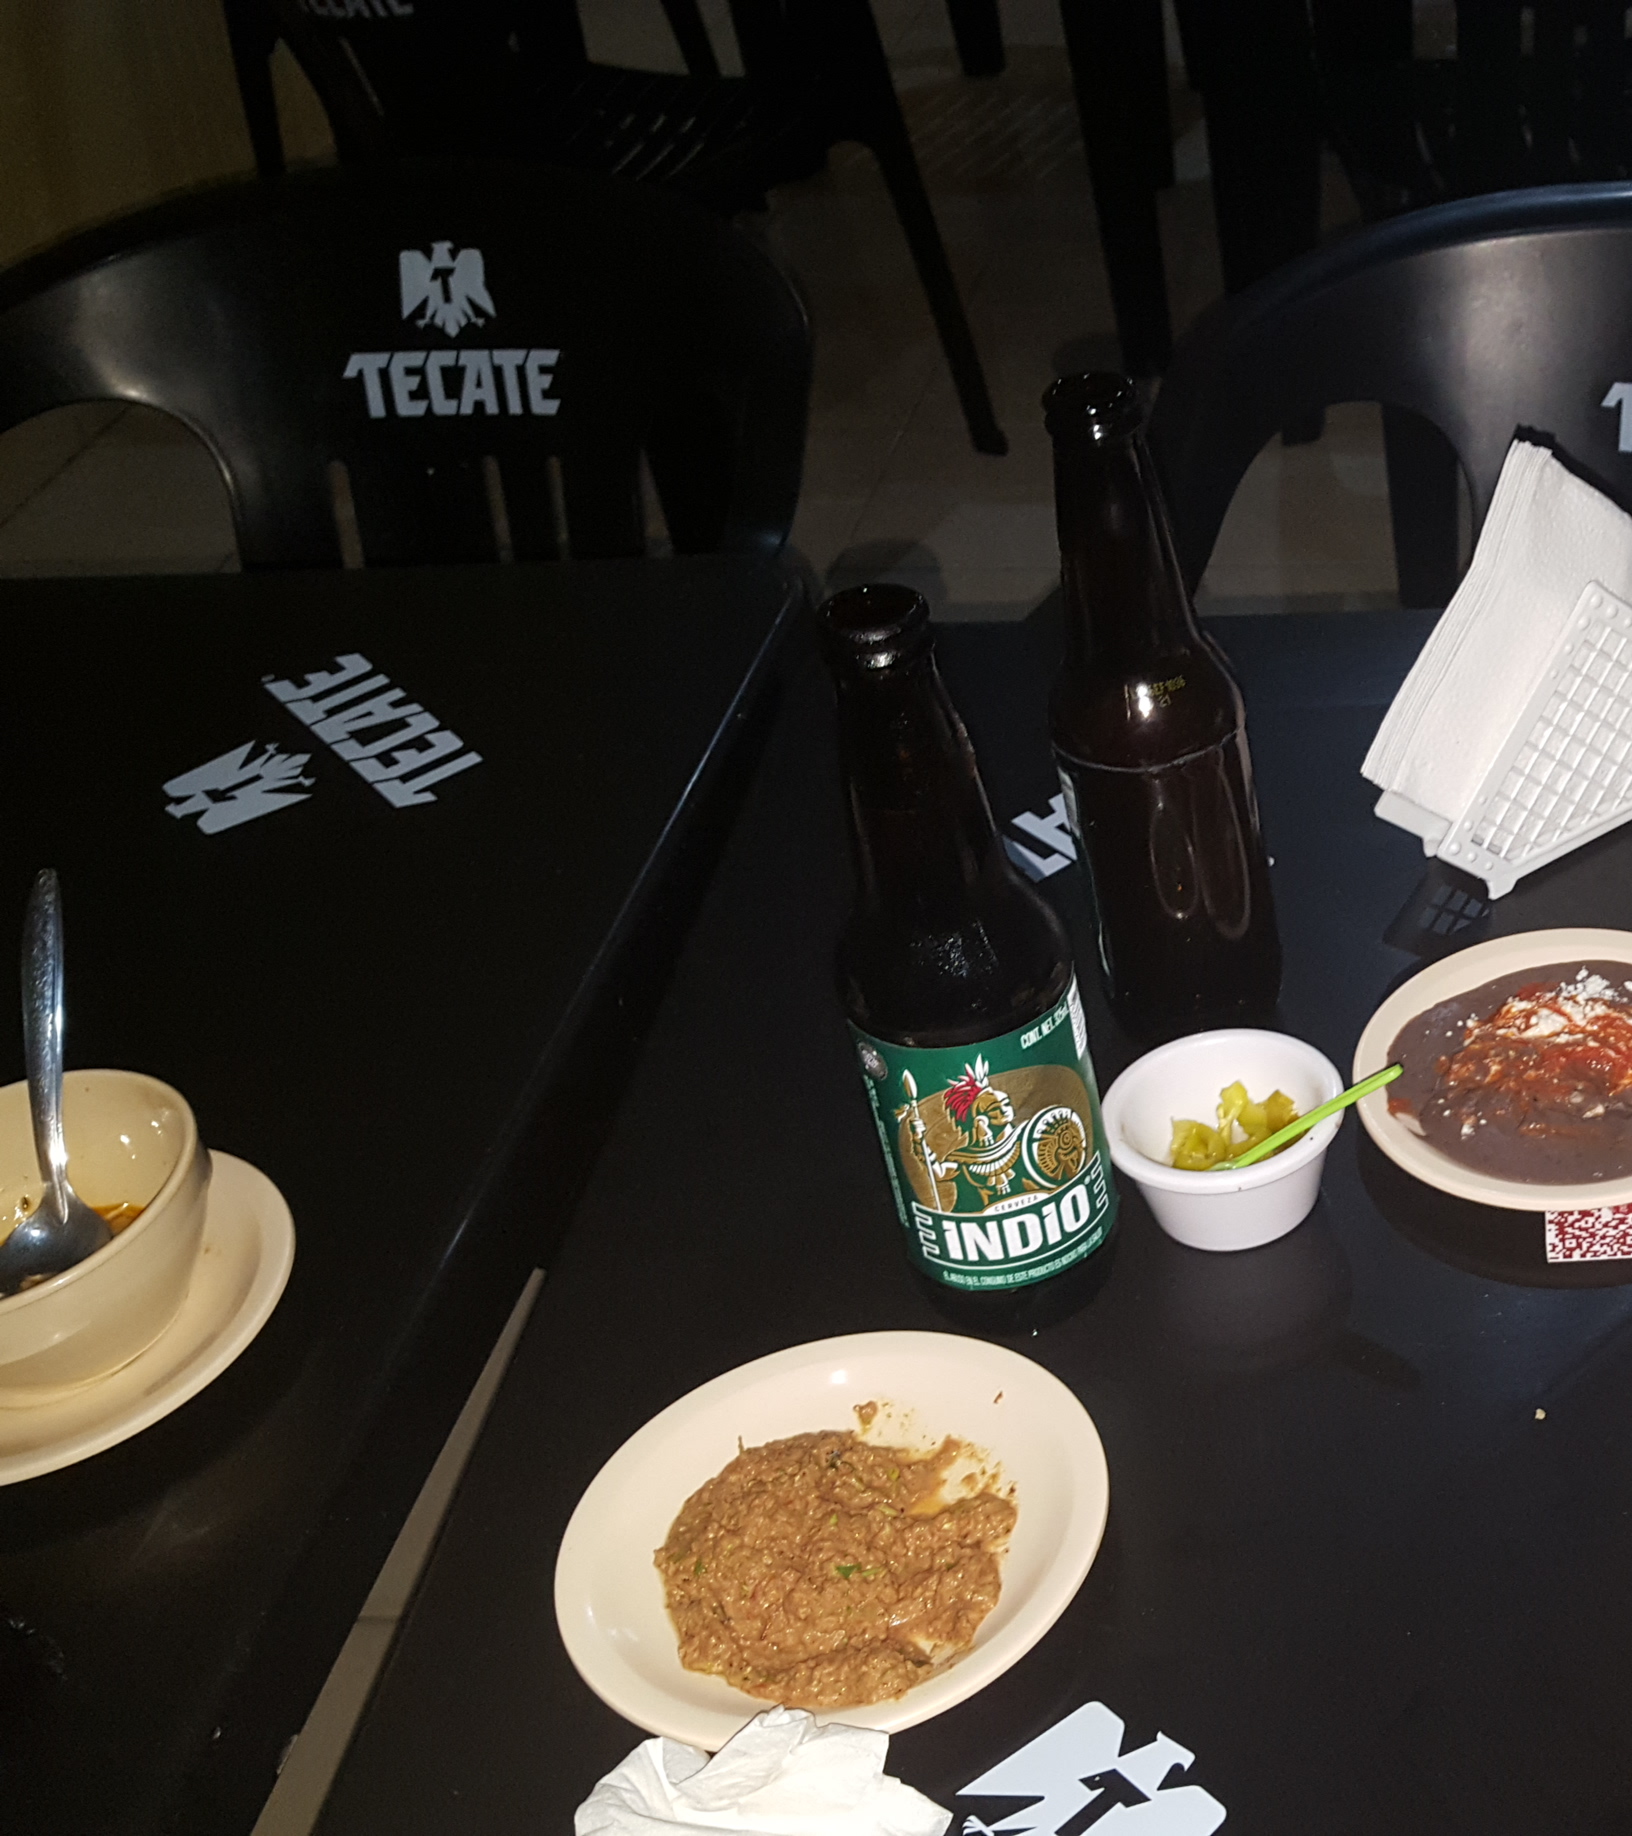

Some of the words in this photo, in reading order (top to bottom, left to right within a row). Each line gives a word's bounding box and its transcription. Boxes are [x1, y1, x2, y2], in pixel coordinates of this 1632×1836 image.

[343, 350, 560, 416] TECATE
[266, 654, 483, 808] TECATE
[994, 1195, 1039, 1212] CERVEZA
